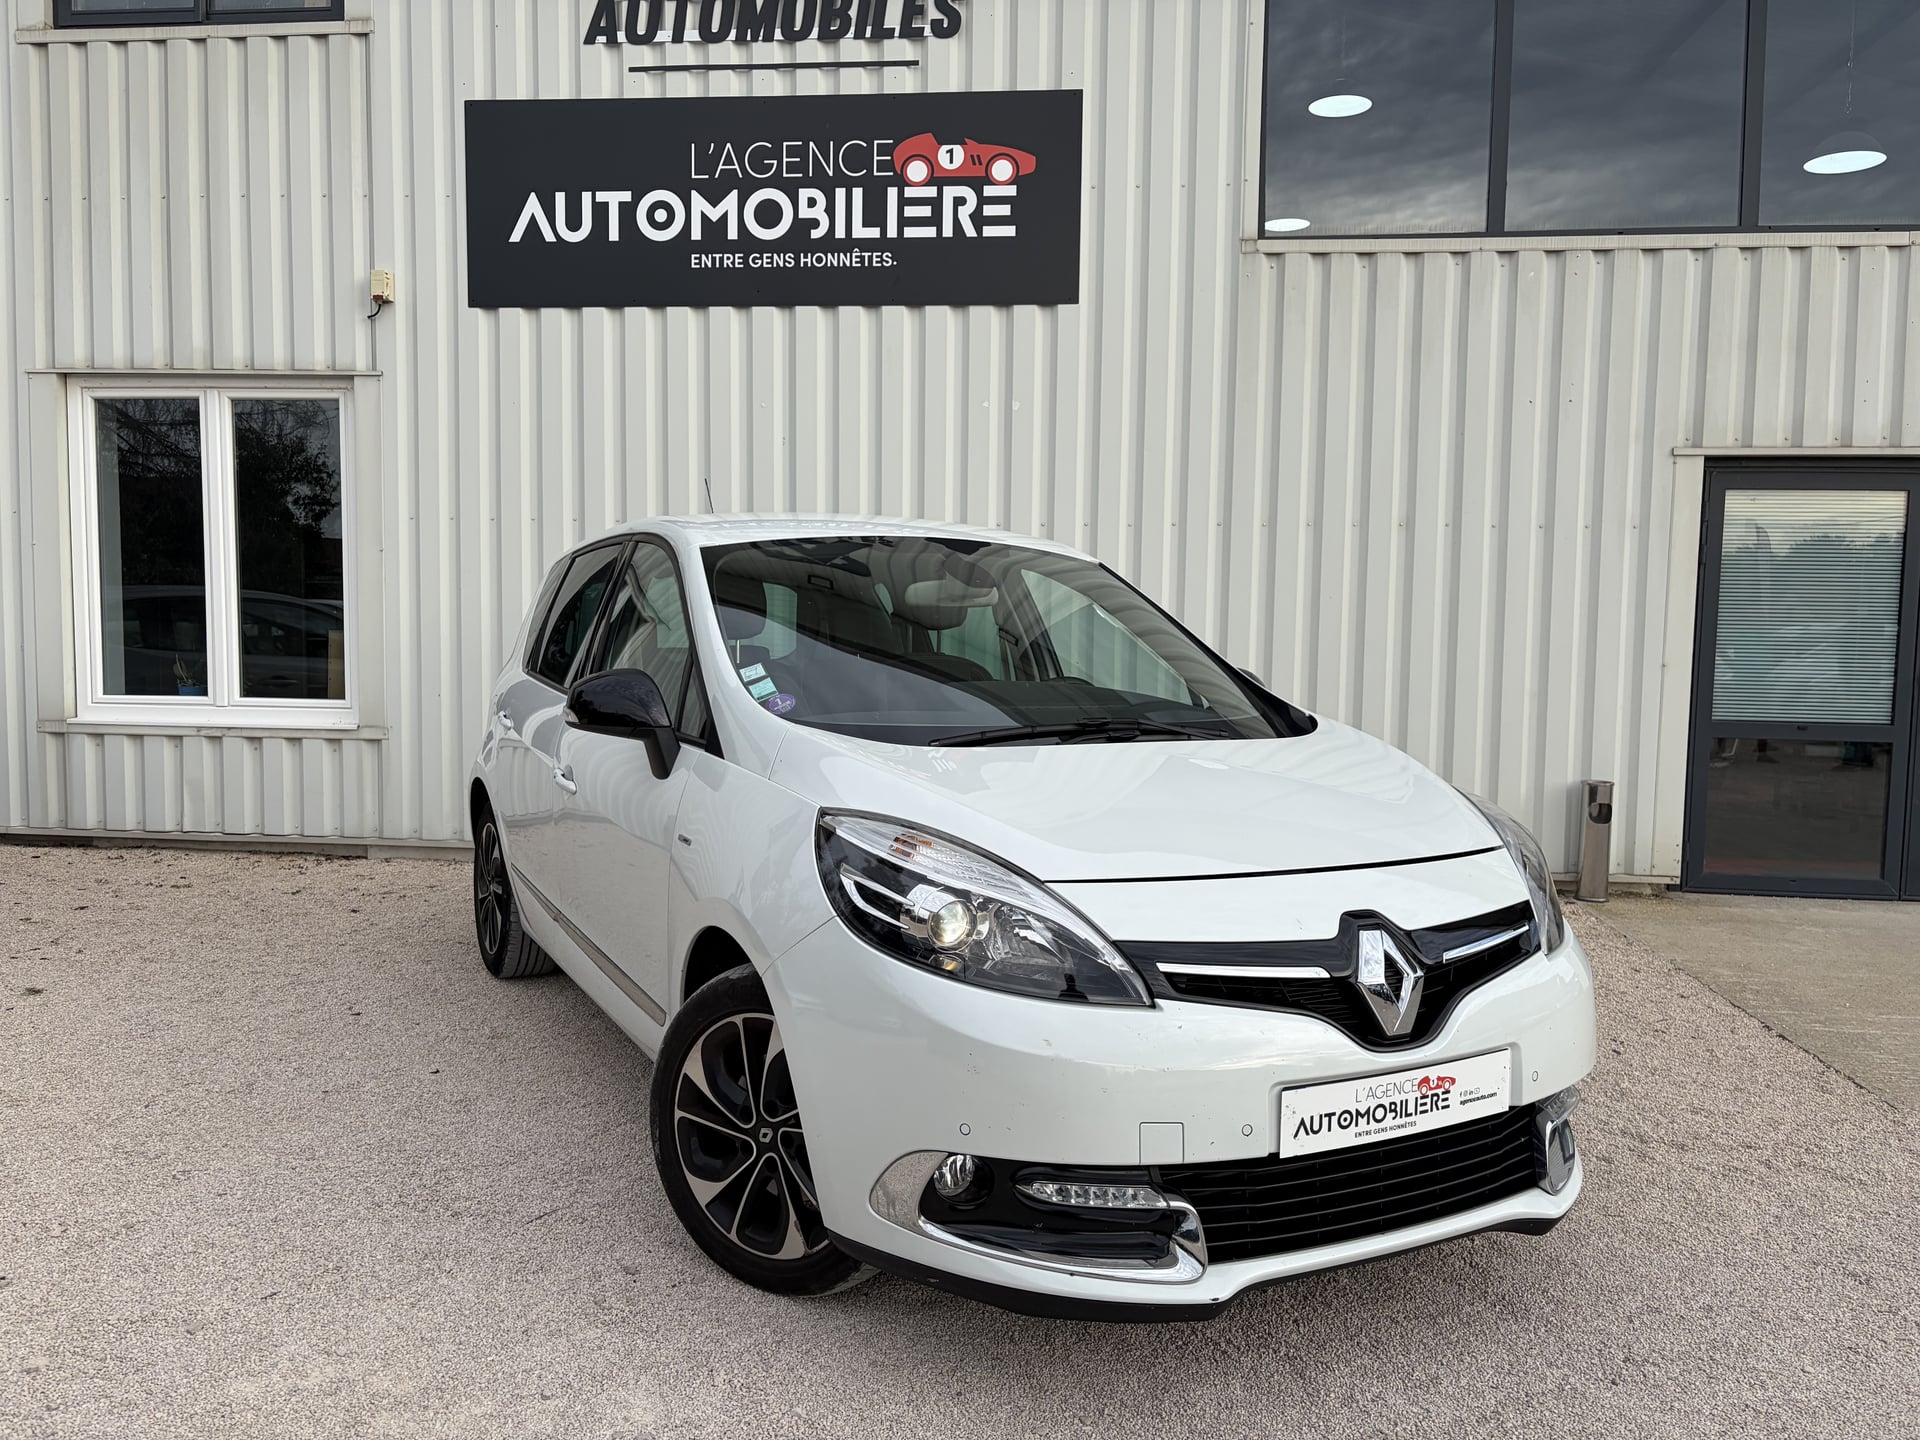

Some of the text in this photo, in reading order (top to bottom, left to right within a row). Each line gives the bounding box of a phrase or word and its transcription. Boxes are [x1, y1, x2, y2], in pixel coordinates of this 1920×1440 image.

[583, 0, 962, 45] AUTOMOBILES
[690, 139, 894, 179] L'AGENCE
[945, 148, 954, 164] 1
[690, 248, 897, 269] ENTRE GENS HONNÊTES.
[1355, 1077, 1419, 1104] L'AGENCE
[1354, 1120, 1417, 1139] ENTRE GENS HONNÊTES
